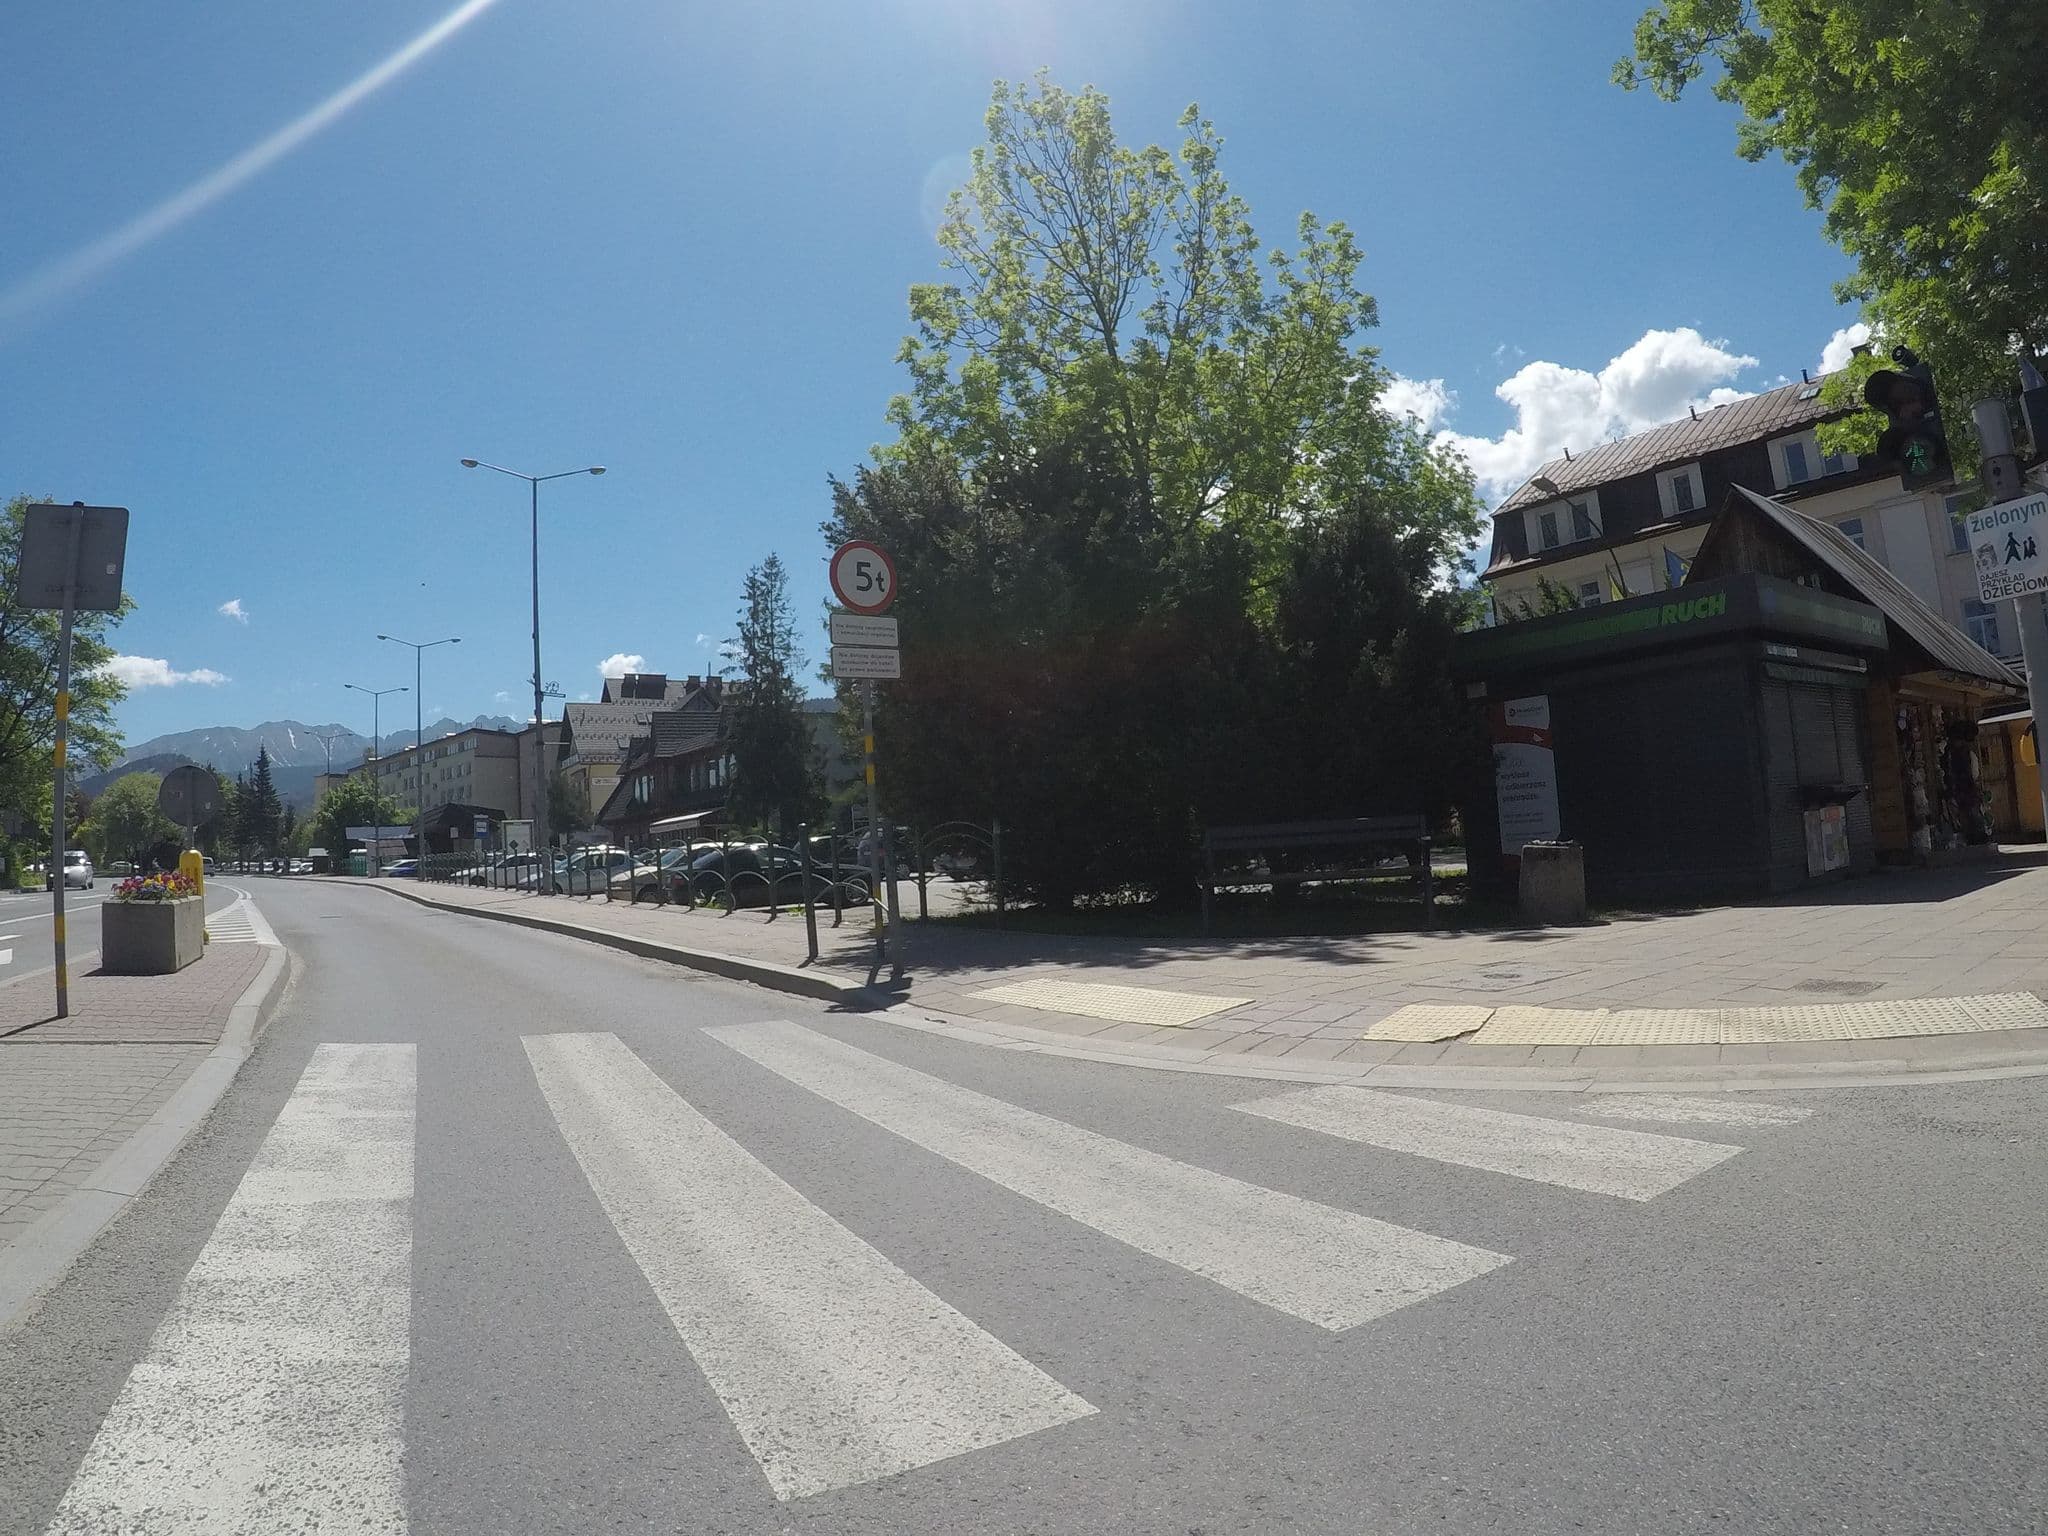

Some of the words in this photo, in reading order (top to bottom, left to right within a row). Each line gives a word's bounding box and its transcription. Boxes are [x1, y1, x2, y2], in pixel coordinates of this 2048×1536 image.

[1971, 500, 2047, 533] zielonym
[856, 561, 885, 592] 5t
[1979, 569, 2009, 582] DAJESZ
[1980, 573, 2026, 589] PRZYKŁAD
[1982, 576, 2048, 601] DZIECIOM
[1662, 594, 1725, 624] RUCH
